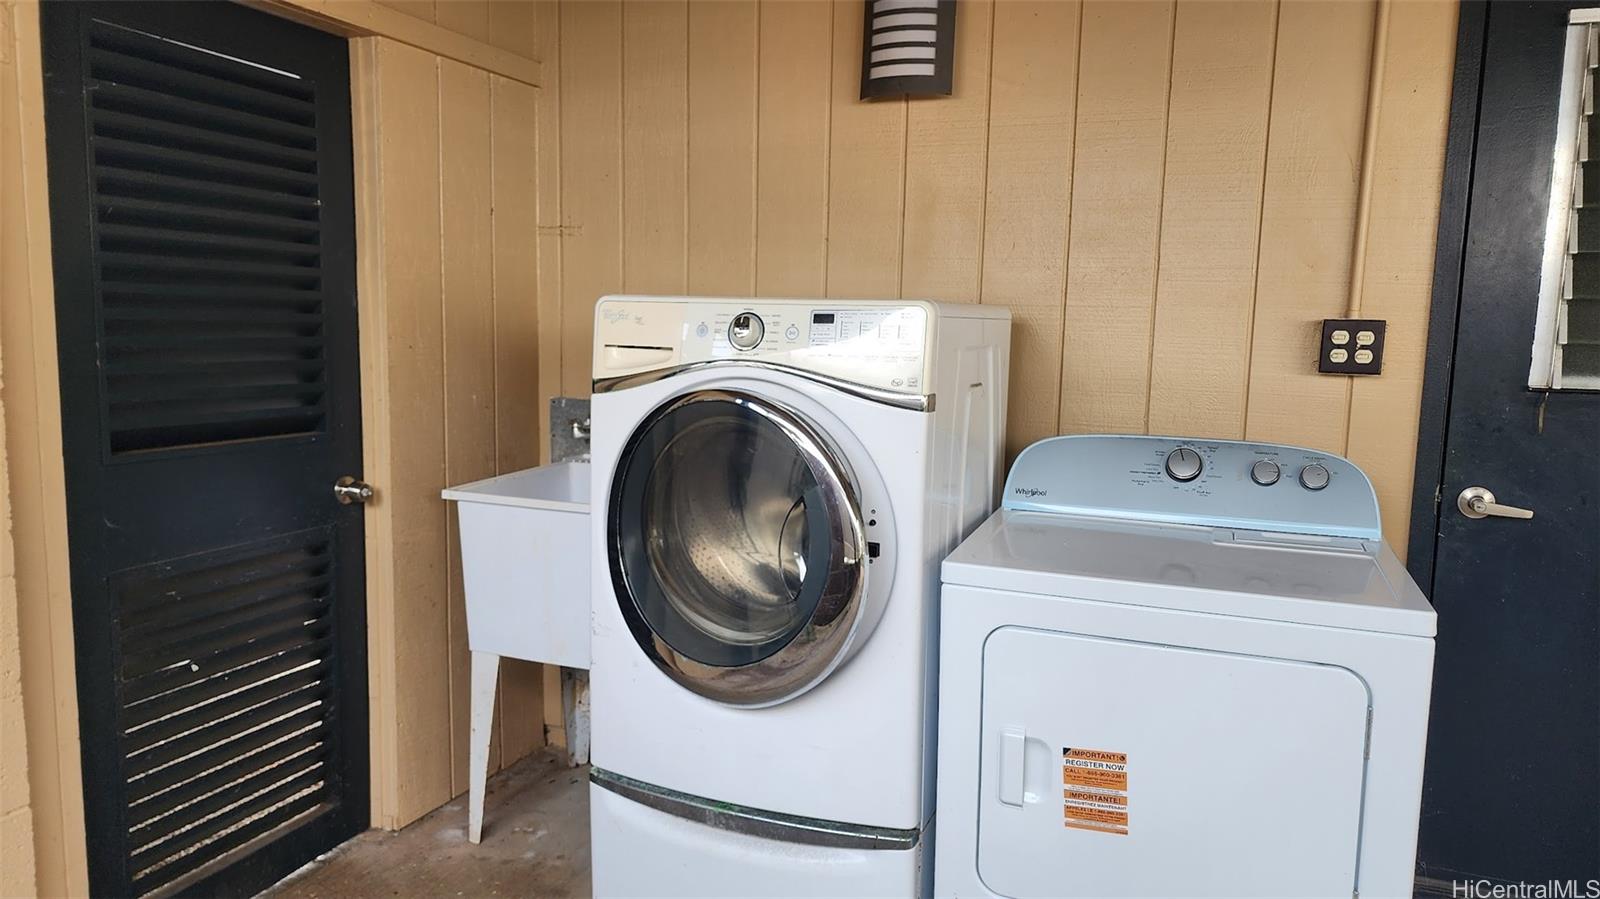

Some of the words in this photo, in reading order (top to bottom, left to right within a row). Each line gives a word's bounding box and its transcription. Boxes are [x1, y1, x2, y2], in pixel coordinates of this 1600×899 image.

[1015, 487, 1047, 498] Whirlpool
[1072, 750, 1119, 760] IMPORTANT!
[1065, 759, 1104, 769] REGISTER
[1105, 763, 1125, 771] NOW
[1065, 767, 1080, 775] CALL
